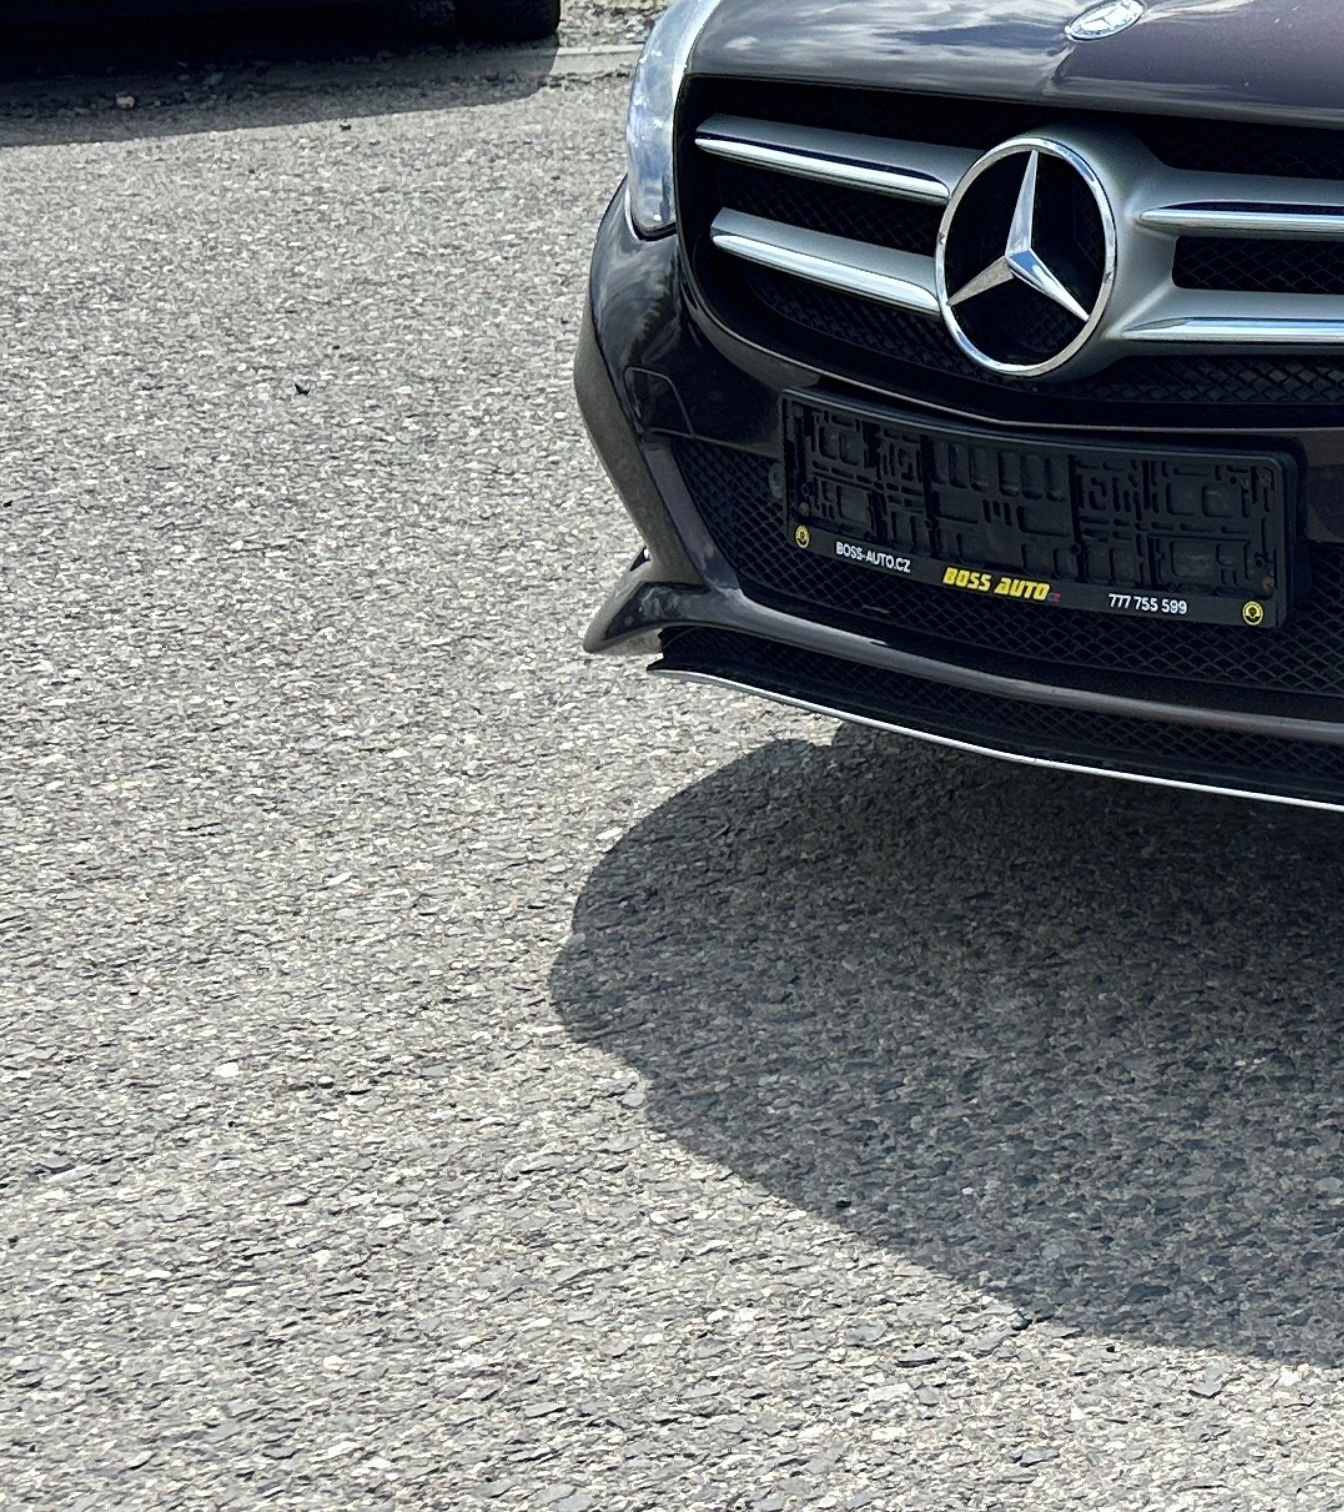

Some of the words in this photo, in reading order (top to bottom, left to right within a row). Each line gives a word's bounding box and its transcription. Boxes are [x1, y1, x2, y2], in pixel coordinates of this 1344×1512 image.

[835, 541, 911, 574] BOSS-AUTO.CZ
[942, 567, 993, 592] BOSS
[994, 577, 1051, 602] AUTO
[1108, 593, 1132, 608] 777
[1133, 595, 1158, 612] 755
[1161, 598, 1188, 615] 599
